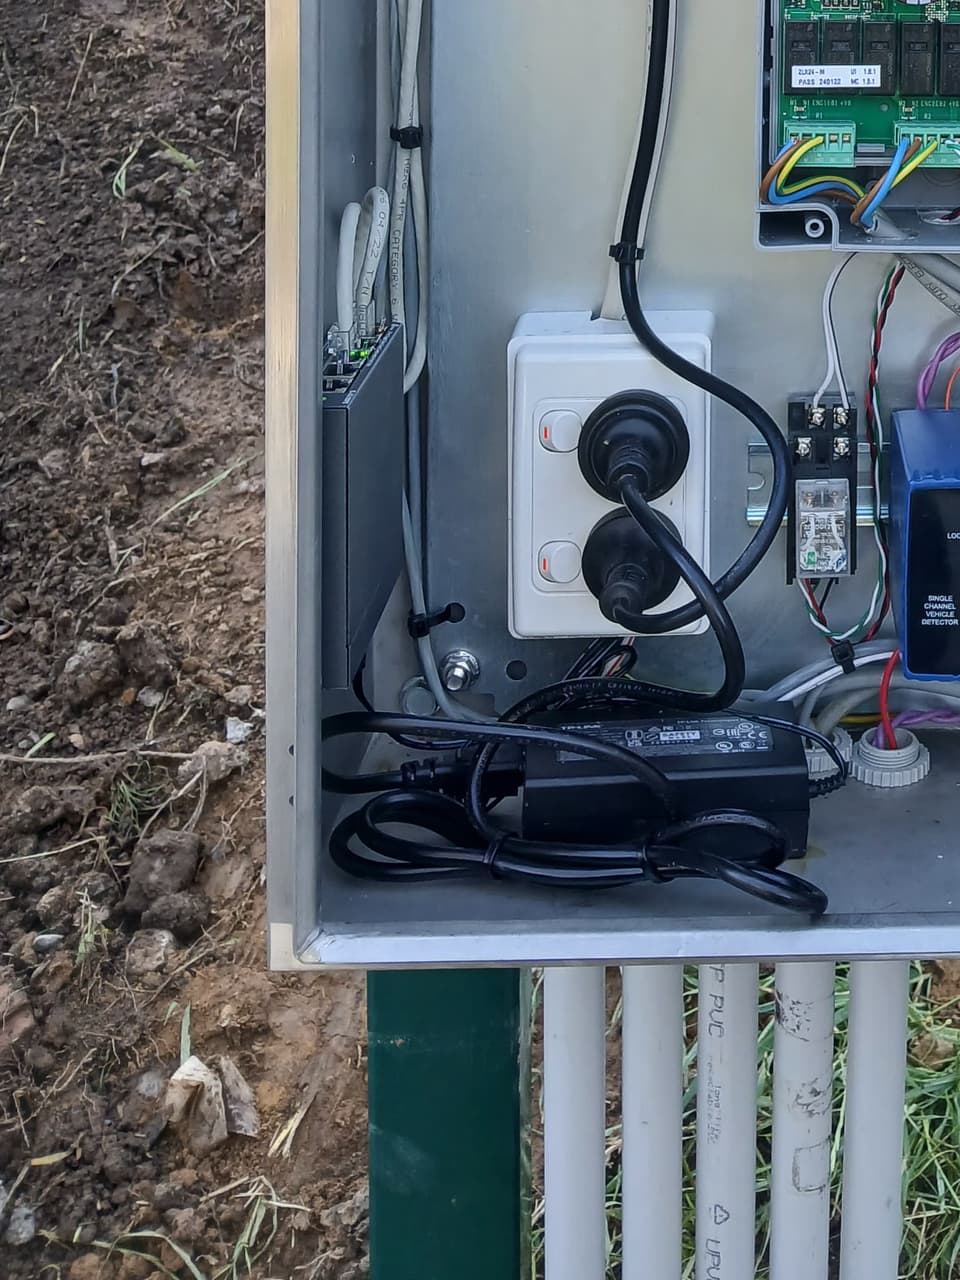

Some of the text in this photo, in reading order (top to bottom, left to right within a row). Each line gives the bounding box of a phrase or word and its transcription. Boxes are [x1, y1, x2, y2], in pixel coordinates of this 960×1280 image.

[391, 229, 401, 290] CATEGORY
[928, 594, 953, 602] SINGLE
[923, 602, 957, 610] CHANNEL
[925, 610, 955, 618] VEHICLE
[921, 618, 959, 626] DETECTOR
[707, 993, 725, 1039] PVC
